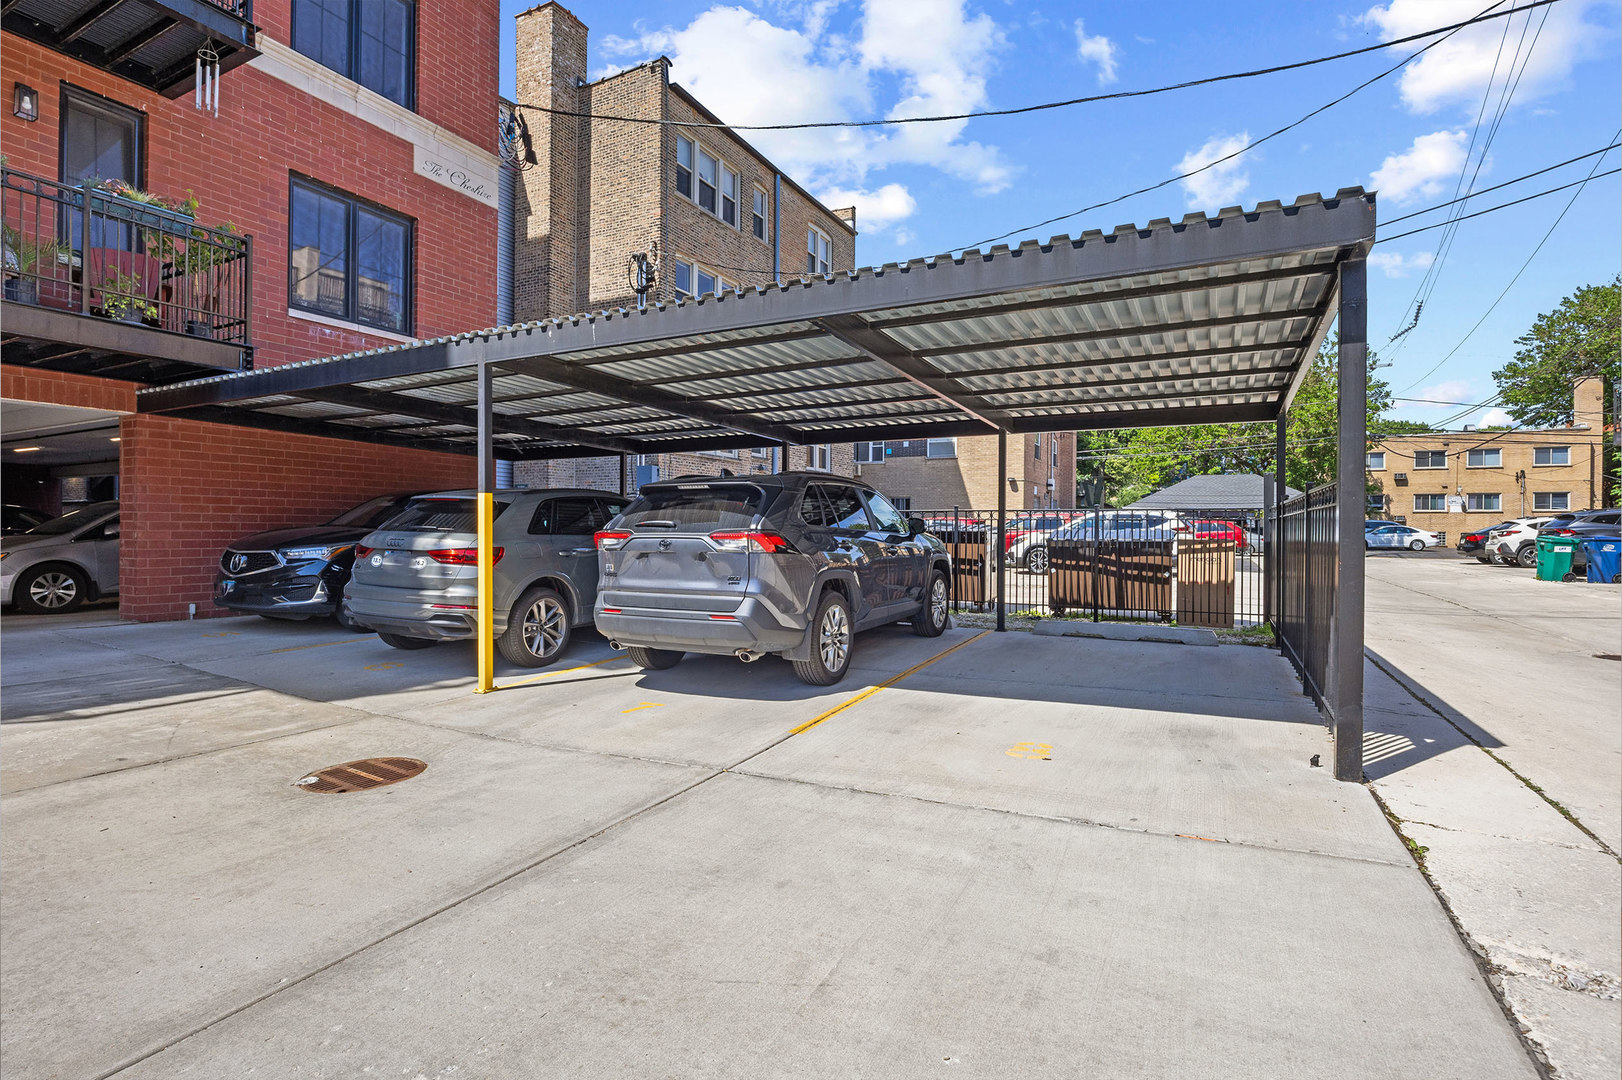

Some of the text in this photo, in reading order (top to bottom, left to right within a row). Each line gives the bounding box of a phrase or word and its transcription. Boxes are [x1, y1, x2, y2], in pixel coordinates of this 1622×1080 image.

[422, 160, 492, 199] The Cheshire
[620, 702, 665, 713] 7
